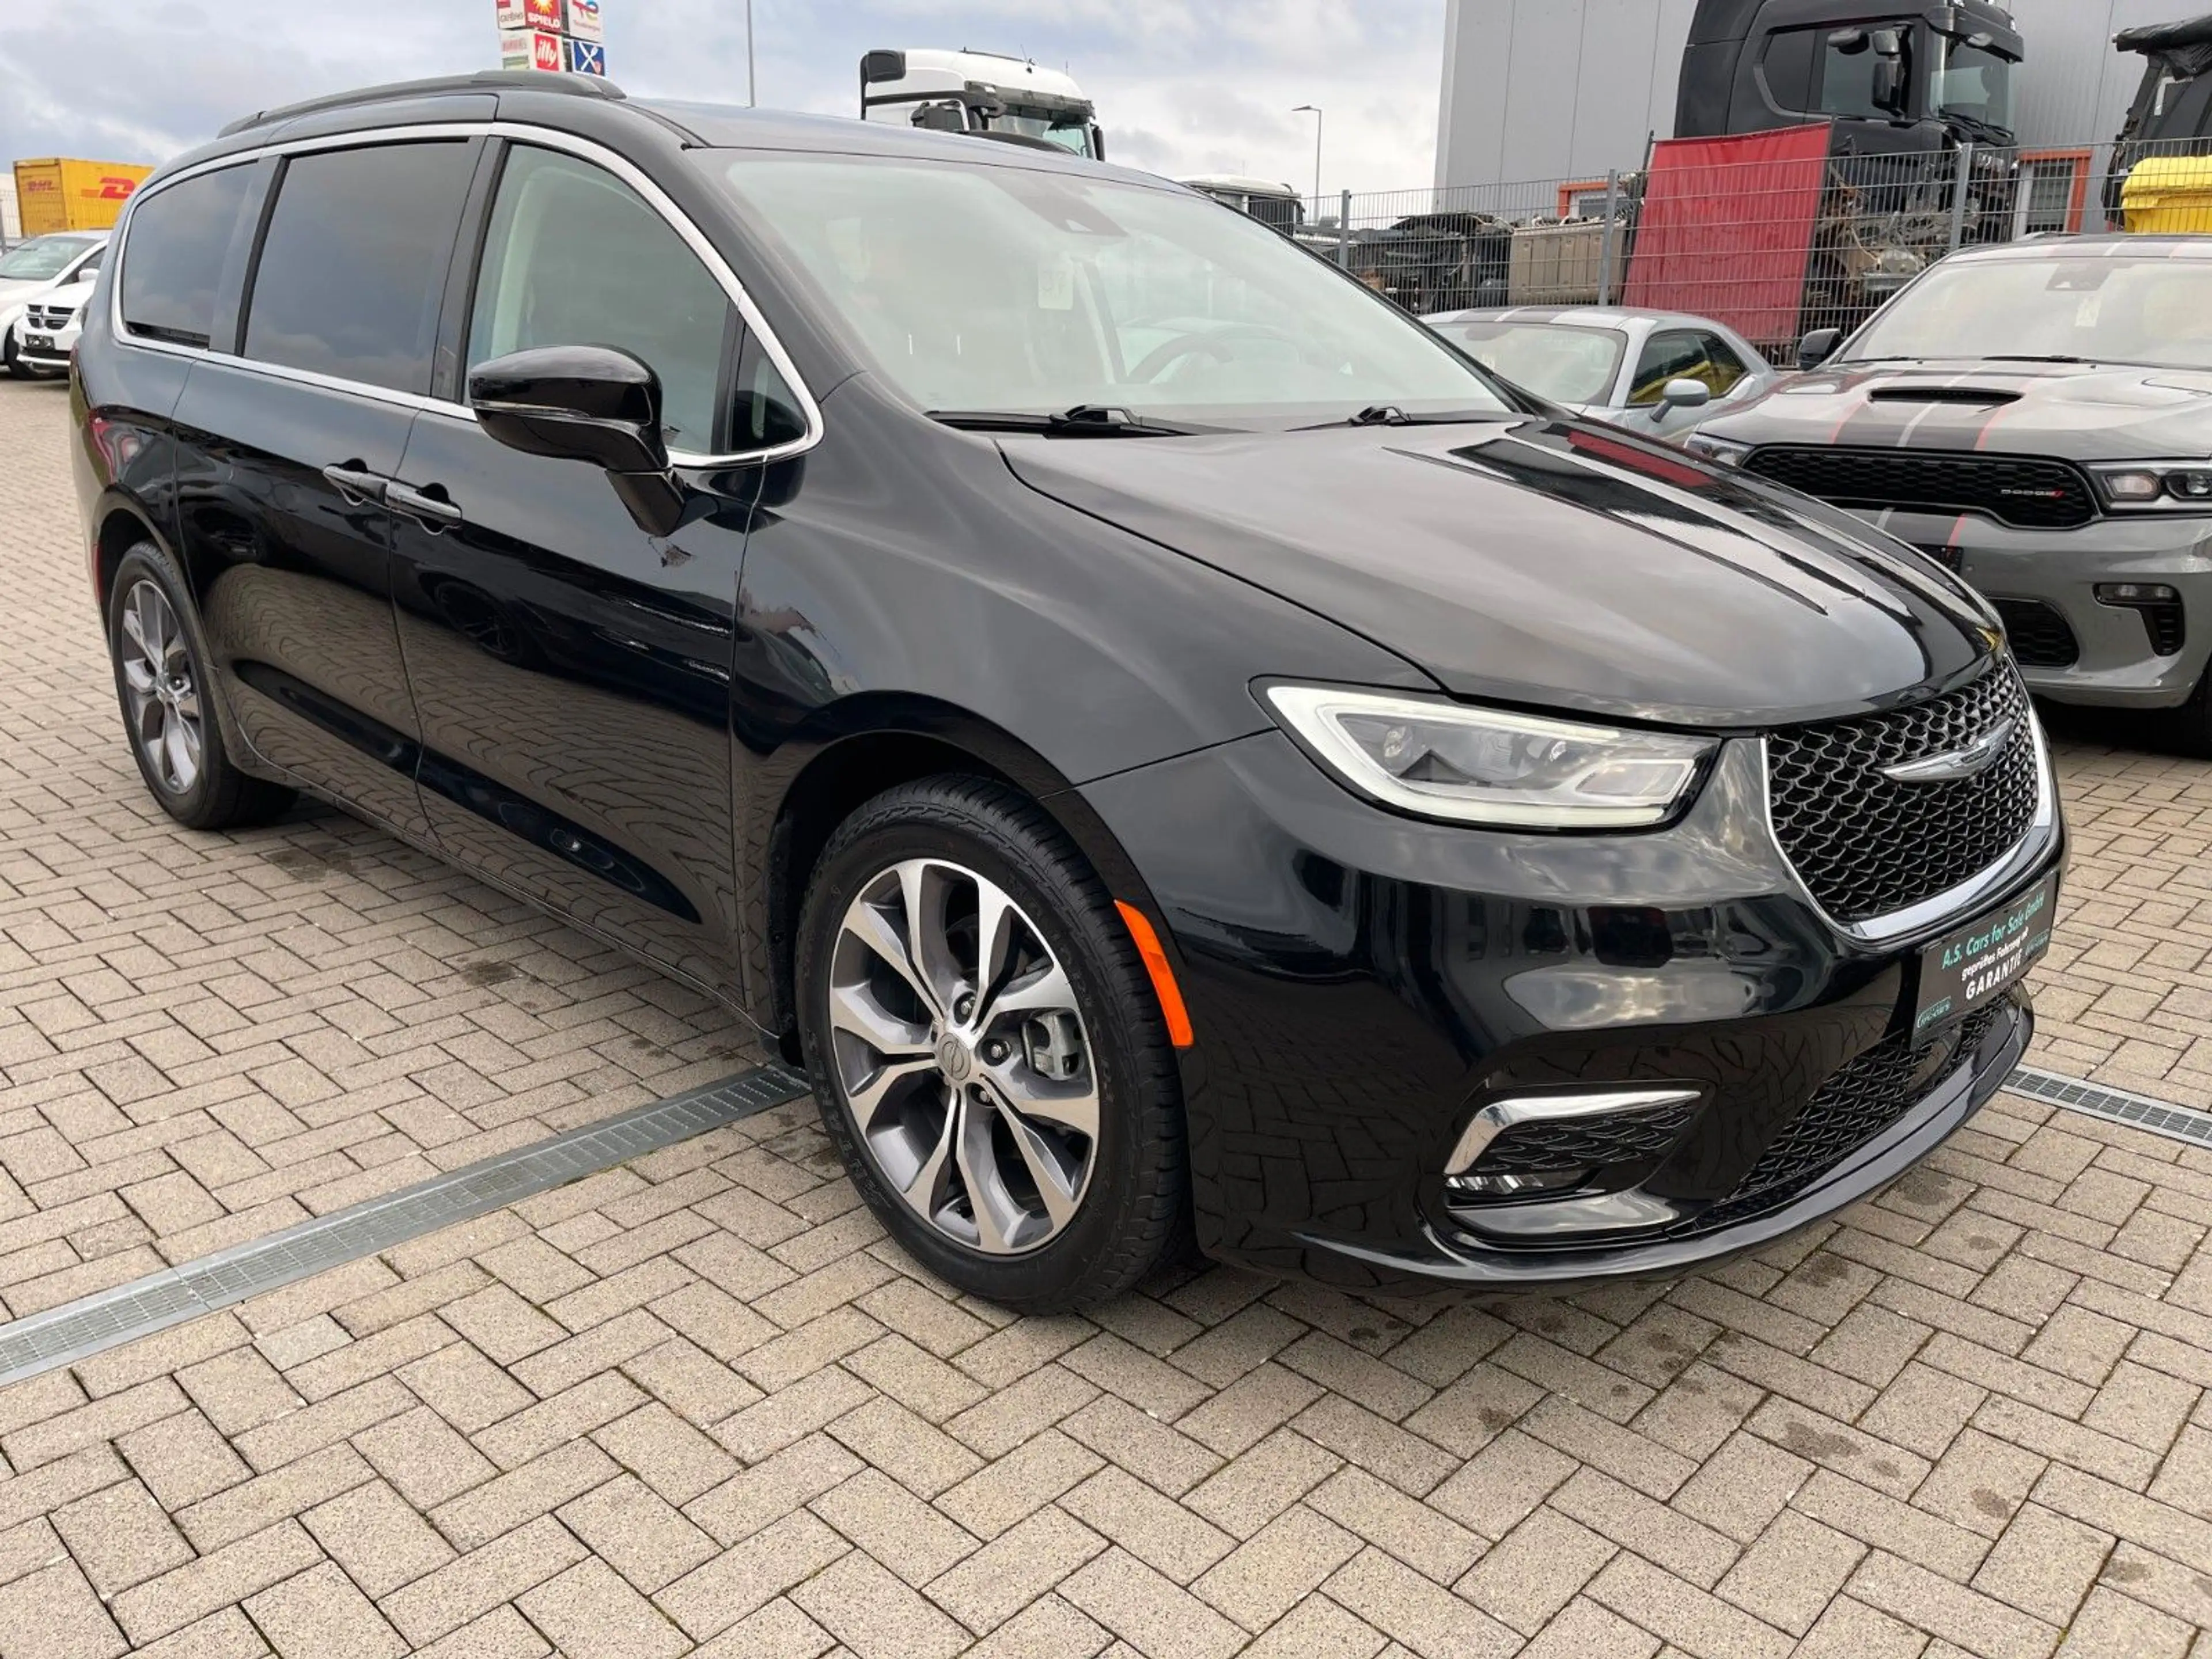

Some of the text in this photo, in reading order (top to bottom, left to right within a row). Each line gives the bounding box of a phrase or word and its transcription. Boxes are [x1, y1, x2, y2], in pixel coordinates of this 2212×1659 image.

[537, 39, 557, 67] illy
[27, 179, 55, 191] DHL
[1942, 943, 1962, 969] A.S.
[1966, 934, 1990, 956] Cars
[1991, 924, 2006, 944] for
[1965, 948, 2022, 1000] GARANTIE
